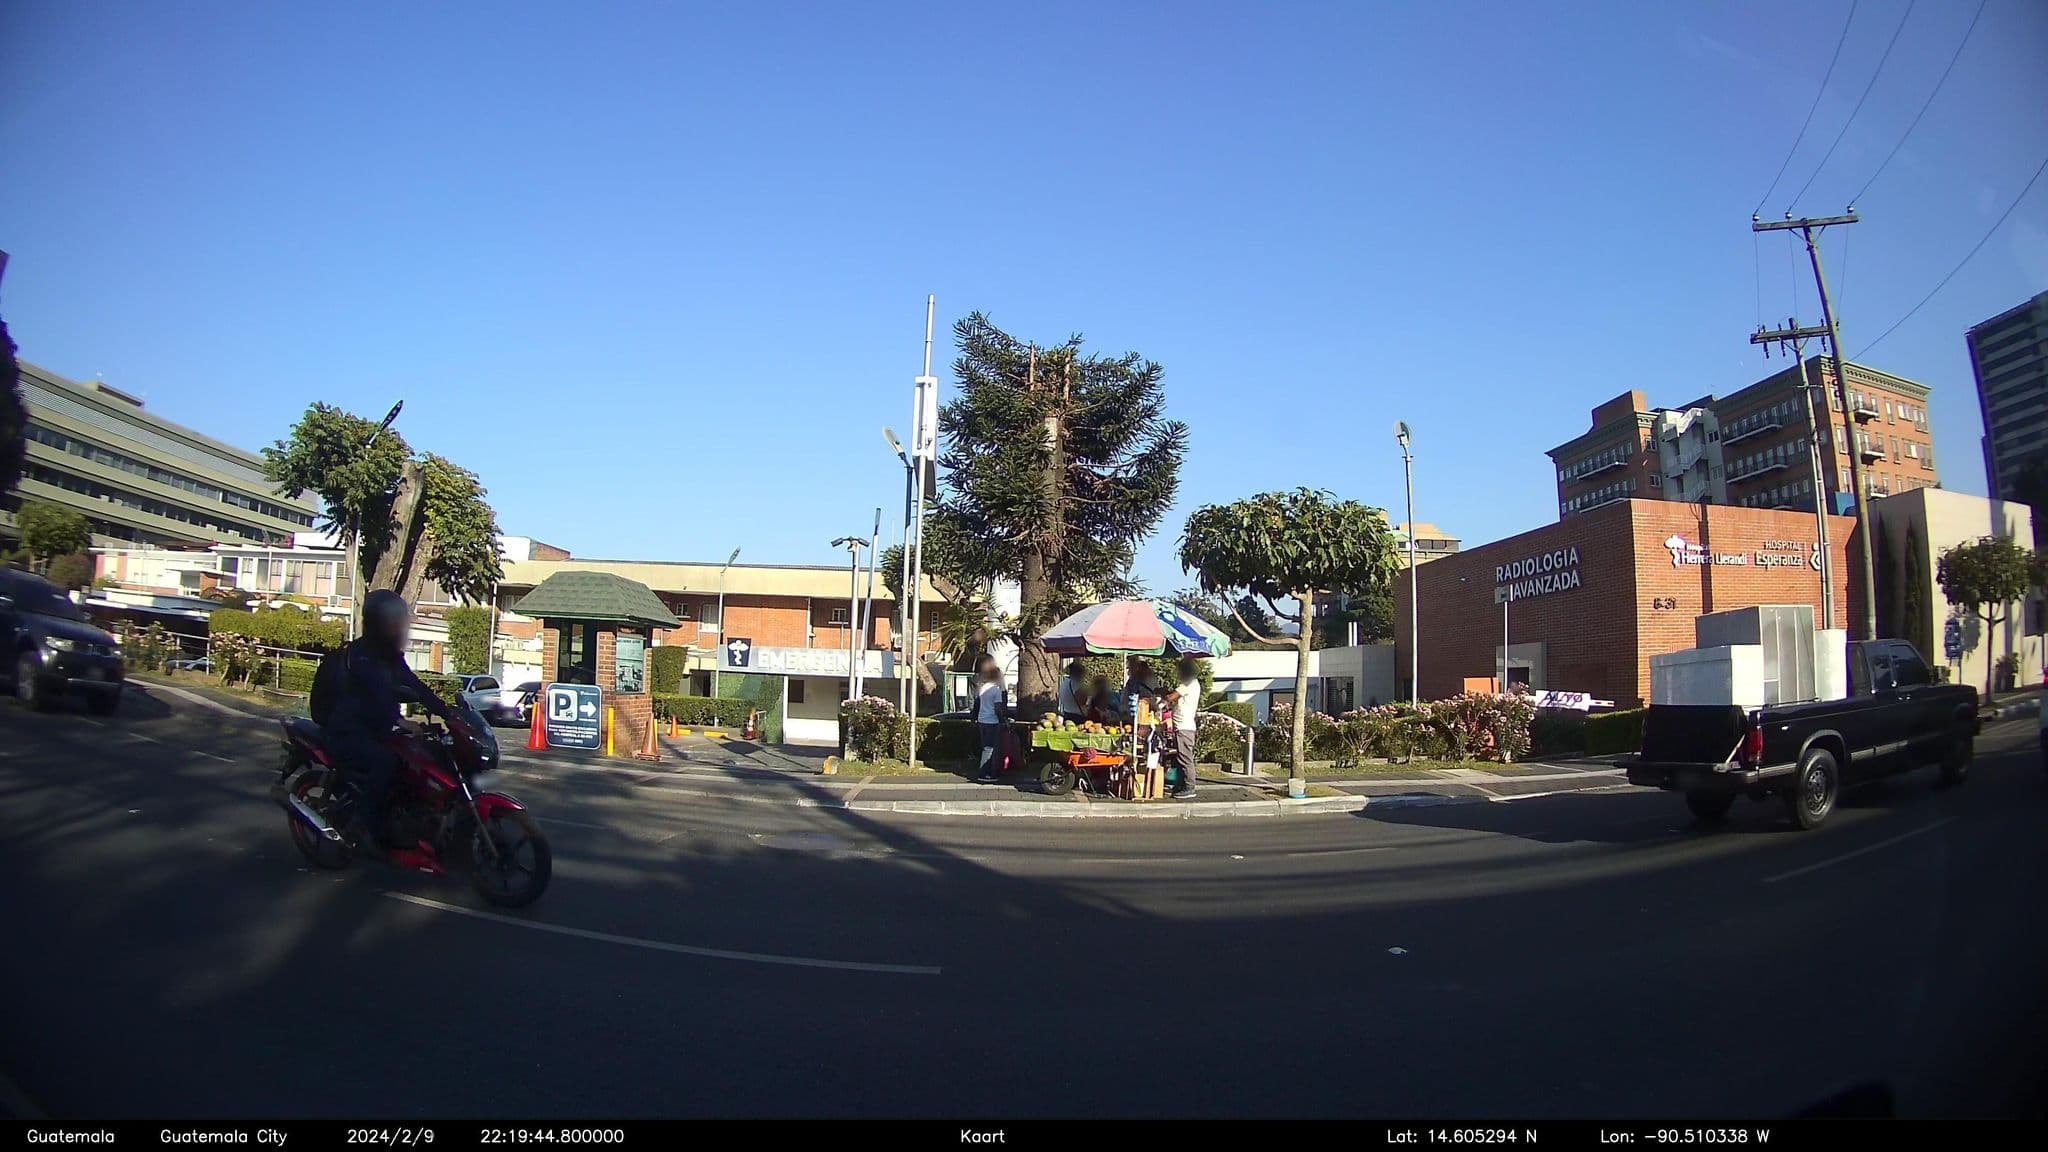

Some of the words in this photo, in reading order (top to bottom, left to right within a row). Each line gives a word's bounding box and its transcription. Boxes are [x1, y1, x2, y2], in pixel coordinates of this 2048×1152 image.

[1496, 547, 1579, 583] RADIOLOGIA
[1756, 551, 1803, 569] Esperanza
[1513, 569, 1580, 601] AVANZADA
[555, 693, 571, 717] P
